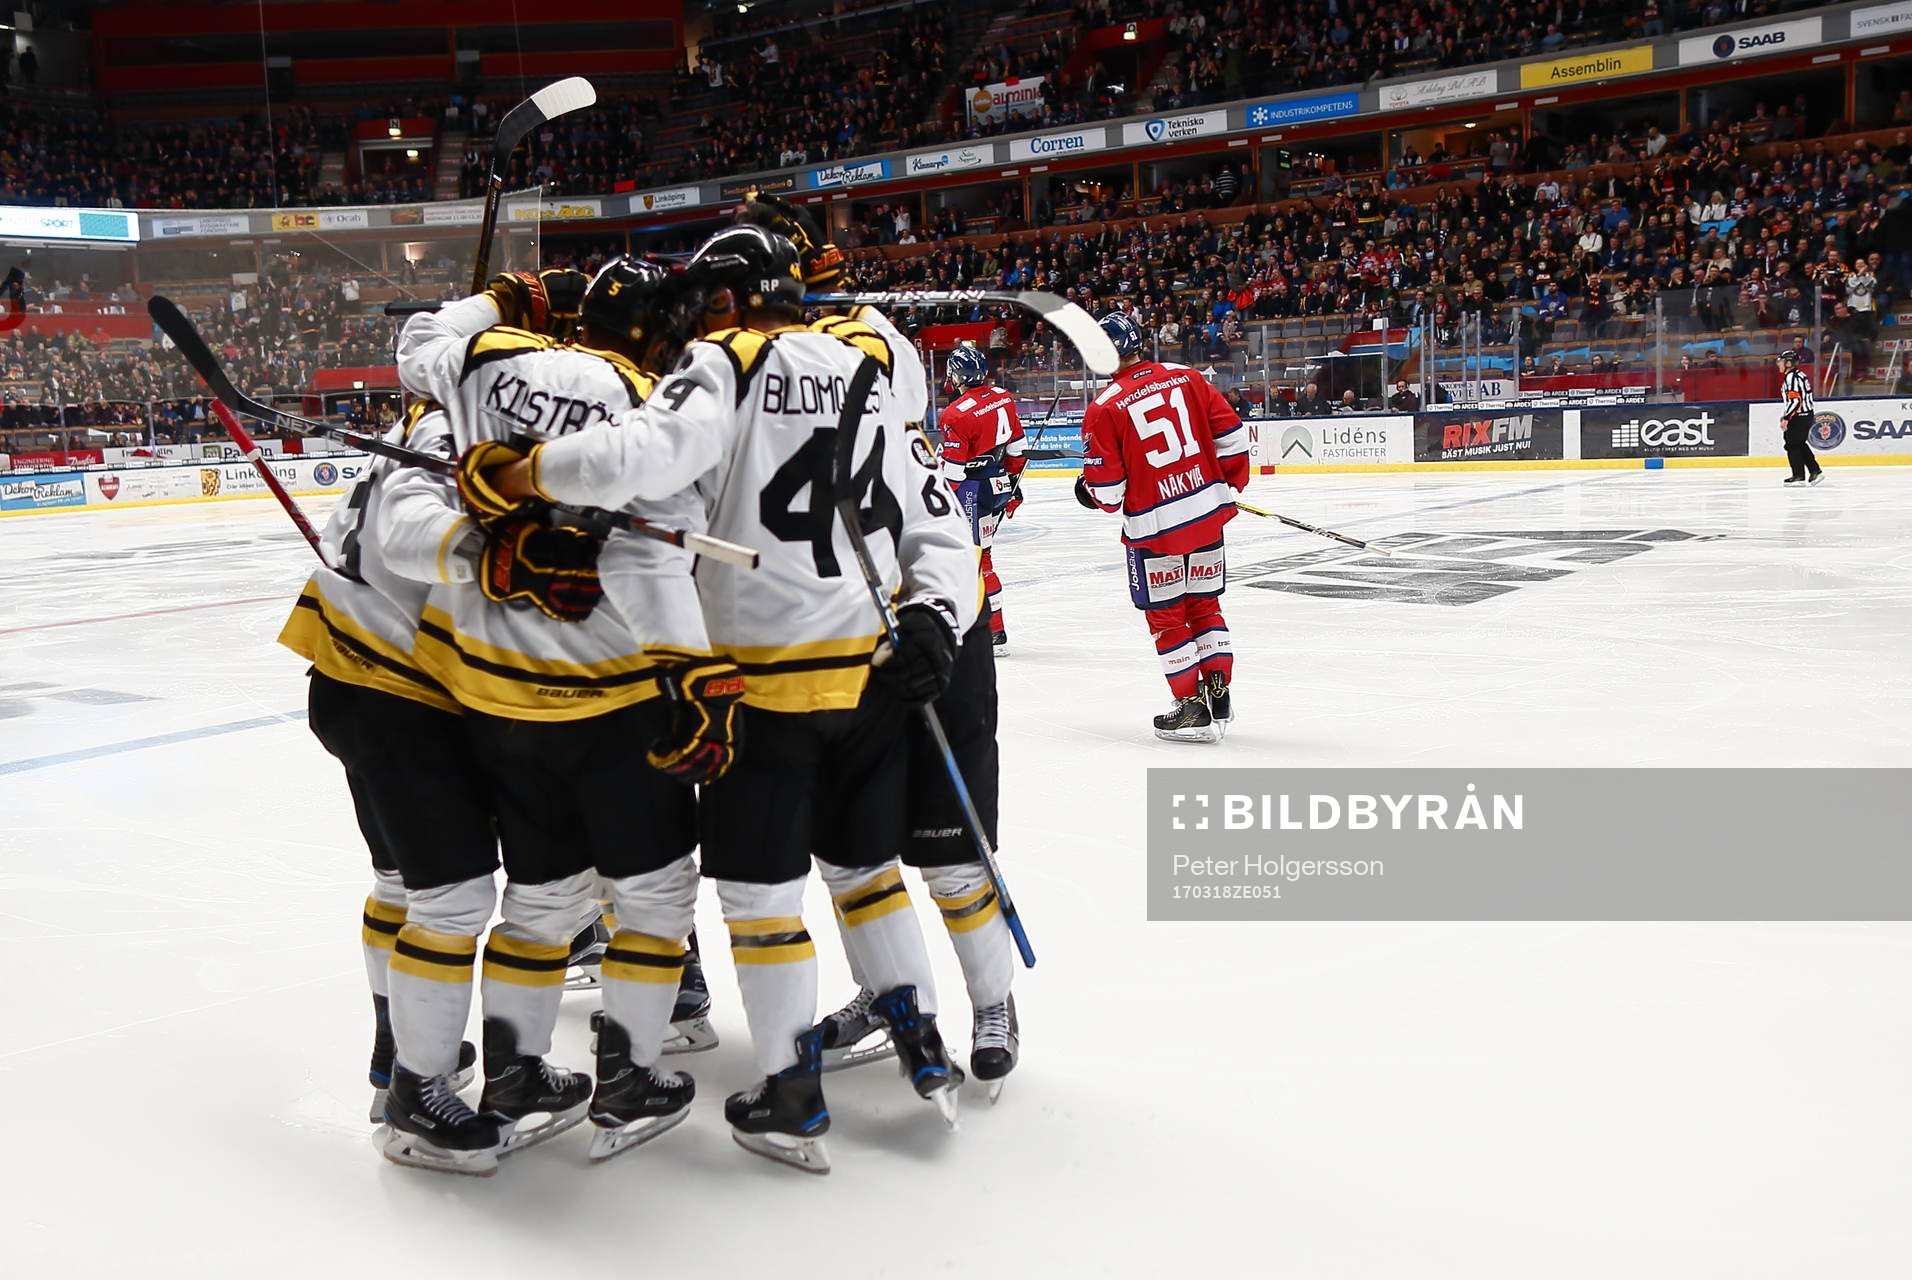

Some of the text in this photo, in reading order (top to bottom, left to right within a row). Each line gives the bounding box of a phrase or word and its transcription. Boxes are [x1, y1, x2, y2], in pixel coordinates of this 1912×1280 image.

[1739, 31, 1785, 49] SAAB
[1551, 59, 1621, 79] Assemblin
[1270, 101, 1354, 119] INDUSTRIKOMPETENS
[1168, 118, 1204, 130] Tekniska
[1168, 128, 1197, 138] verken
[1031, 136, 1084, 153] Corren
[820, 169, 843, 182] Dekor
[842, 167, 875, 184] Reklam
[655, 193, 686, 204] Linköping
[760, 279, 779, 292] RP
[1116, 375, 1190, 410] Handelsbanken
[995, 407, 1013, 446] 4
[1128, 387, 1201, 468] 51
[1443, 414, 1534, 449] RIXFM
[1640, 411, 1715, 447] east
[1322, 428, 1387, 445] Lidéns
[1322, 447, 1387, 458] FASTIGHETER
[1442, 440, 1531, 459] BÄST MUSIK JUST NU!
[13, 458, 54, 466] ENGINEERING
[67, 453, 96, 465] Danfoss
[225, 466, 296, 481] Linking
[4, 483, 35, 496] Dekor
[33, 483, 73, 500] Reklam
[760, 425, 904, 578] 44
[1149, 567, 1184, 585] MAXI
[1190, 562, 1222, 577] MAXI
[1168, 655, 1191, 665] main
[536, 687, 604, 699] BAUER
[912, 827, 963, 838] BAUER
